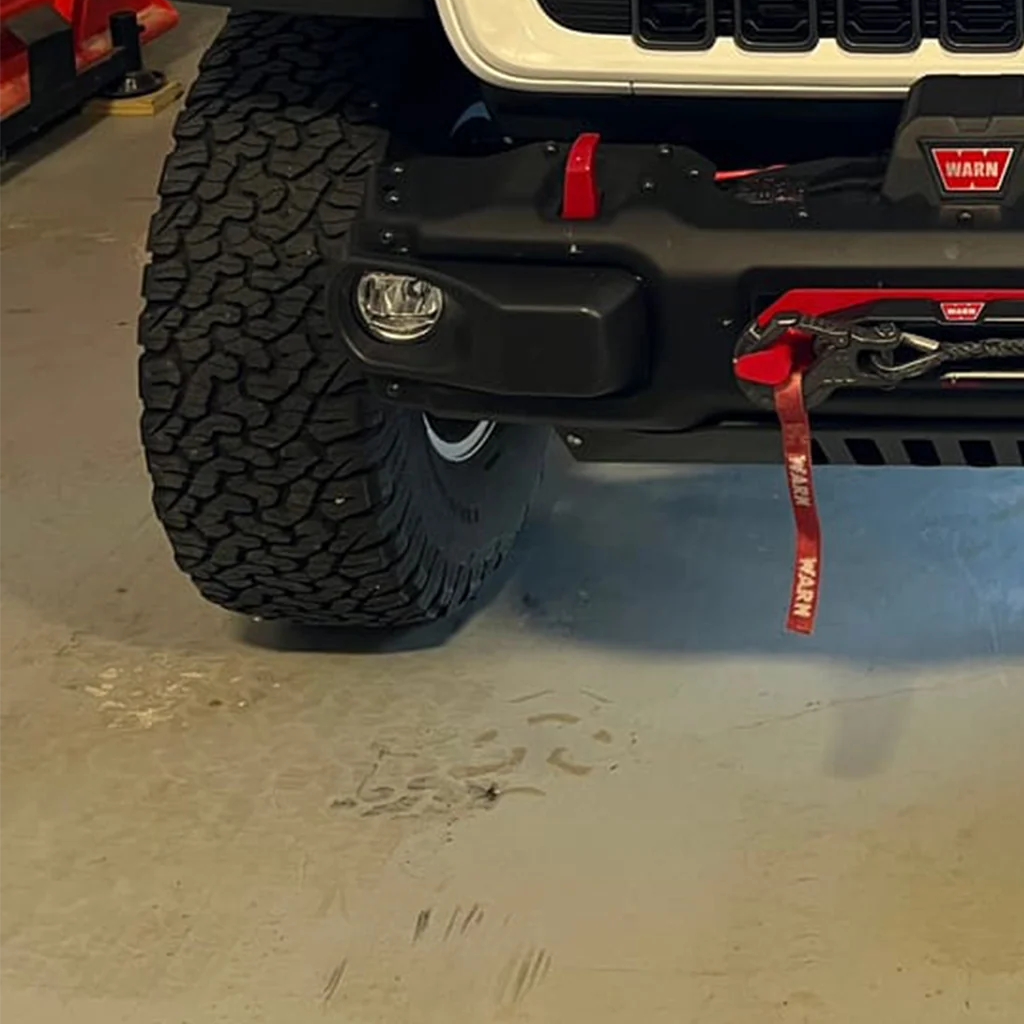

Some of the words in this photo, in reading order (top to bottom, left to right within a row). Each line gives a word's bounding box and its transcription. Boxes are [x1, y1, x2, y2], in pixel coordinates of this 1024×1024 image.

[945, 161, 999, 178] WARN
[788, 454, 812, 507] WARN
[793, 558, 818, 617] WARN
